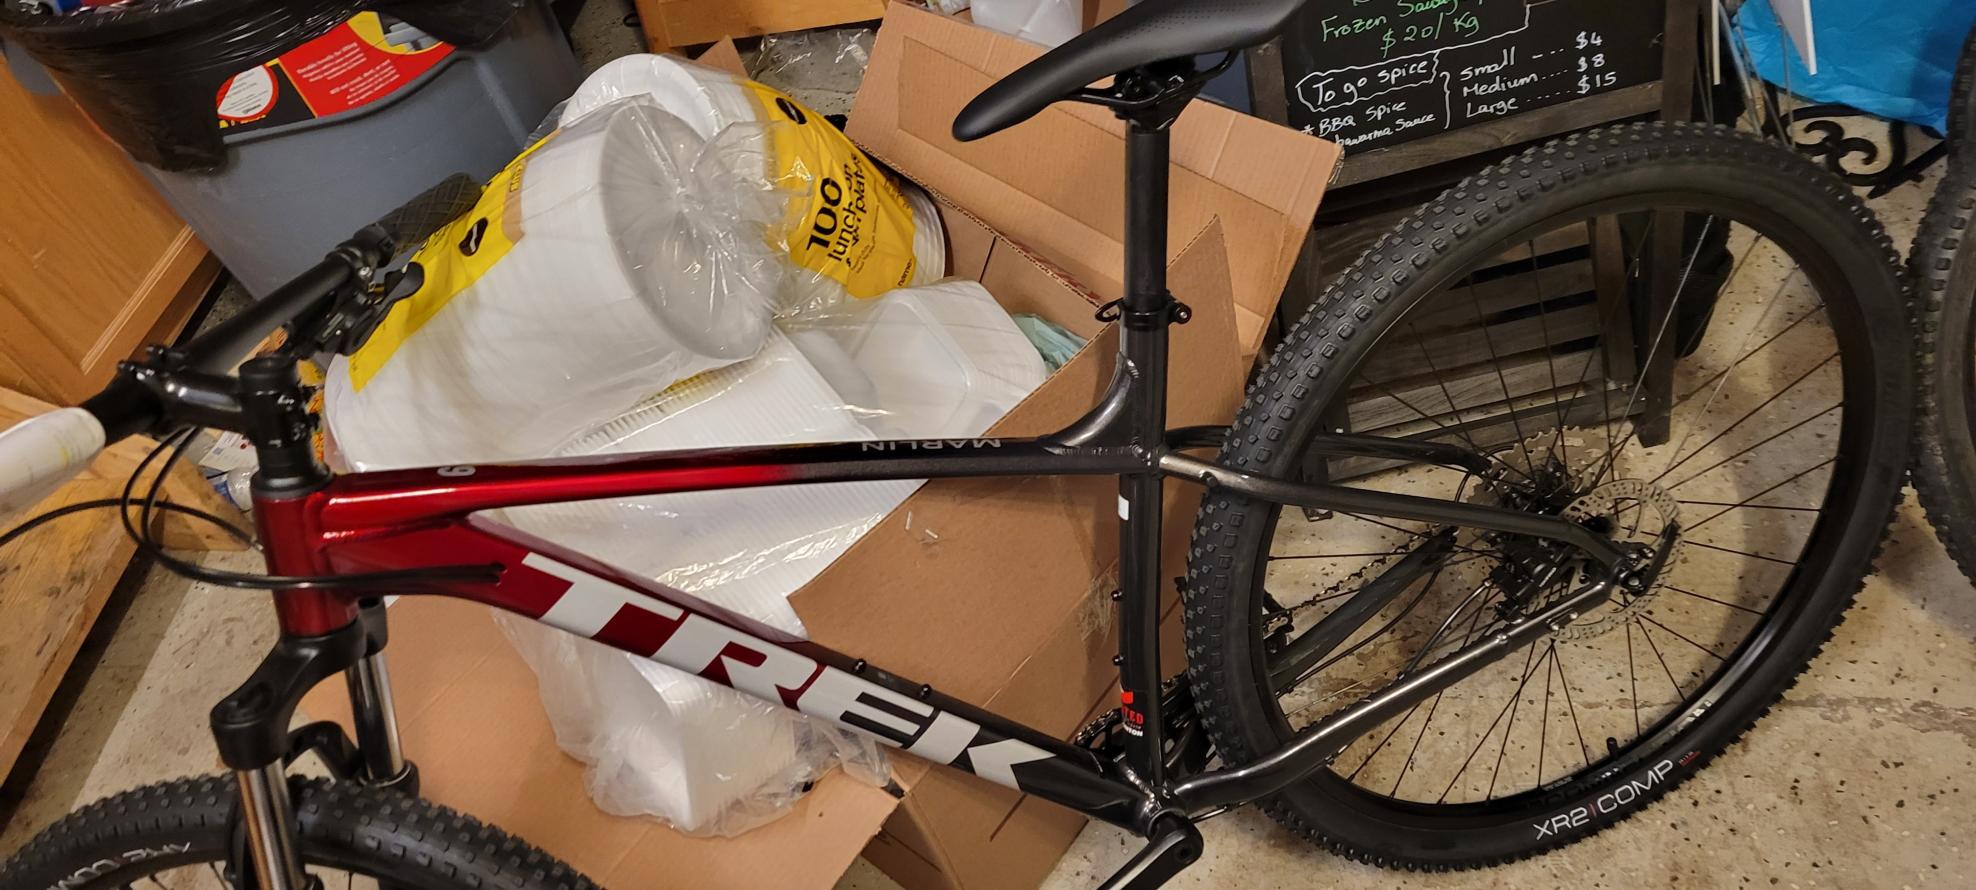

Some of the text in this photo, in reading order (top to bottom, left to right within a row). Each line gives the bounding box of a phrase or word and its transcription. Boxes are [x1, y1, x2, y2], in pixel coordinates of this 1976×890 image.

[1321, 15, 1387, 42] Frozen
[1575, 31, 1603, 50] $4
[1576, 53, 1605, 72] $8
[1312, 77, 1336, 105] To
[1343, 77, 1368, 100] go
[1463, 73, 1538, 97] Medium
[1576, 72, 1617, 94] $15
[1466, 97, 1519, 118] Large
[1319, 115, 1356, 137] BBQ
[1335, 113, 1436, 147] hawarma Sauce
[806, 177, 843, 251] 100
[861, 438, 1001, 452] MARLIN
[521, 551, 1057, 791] TREK
